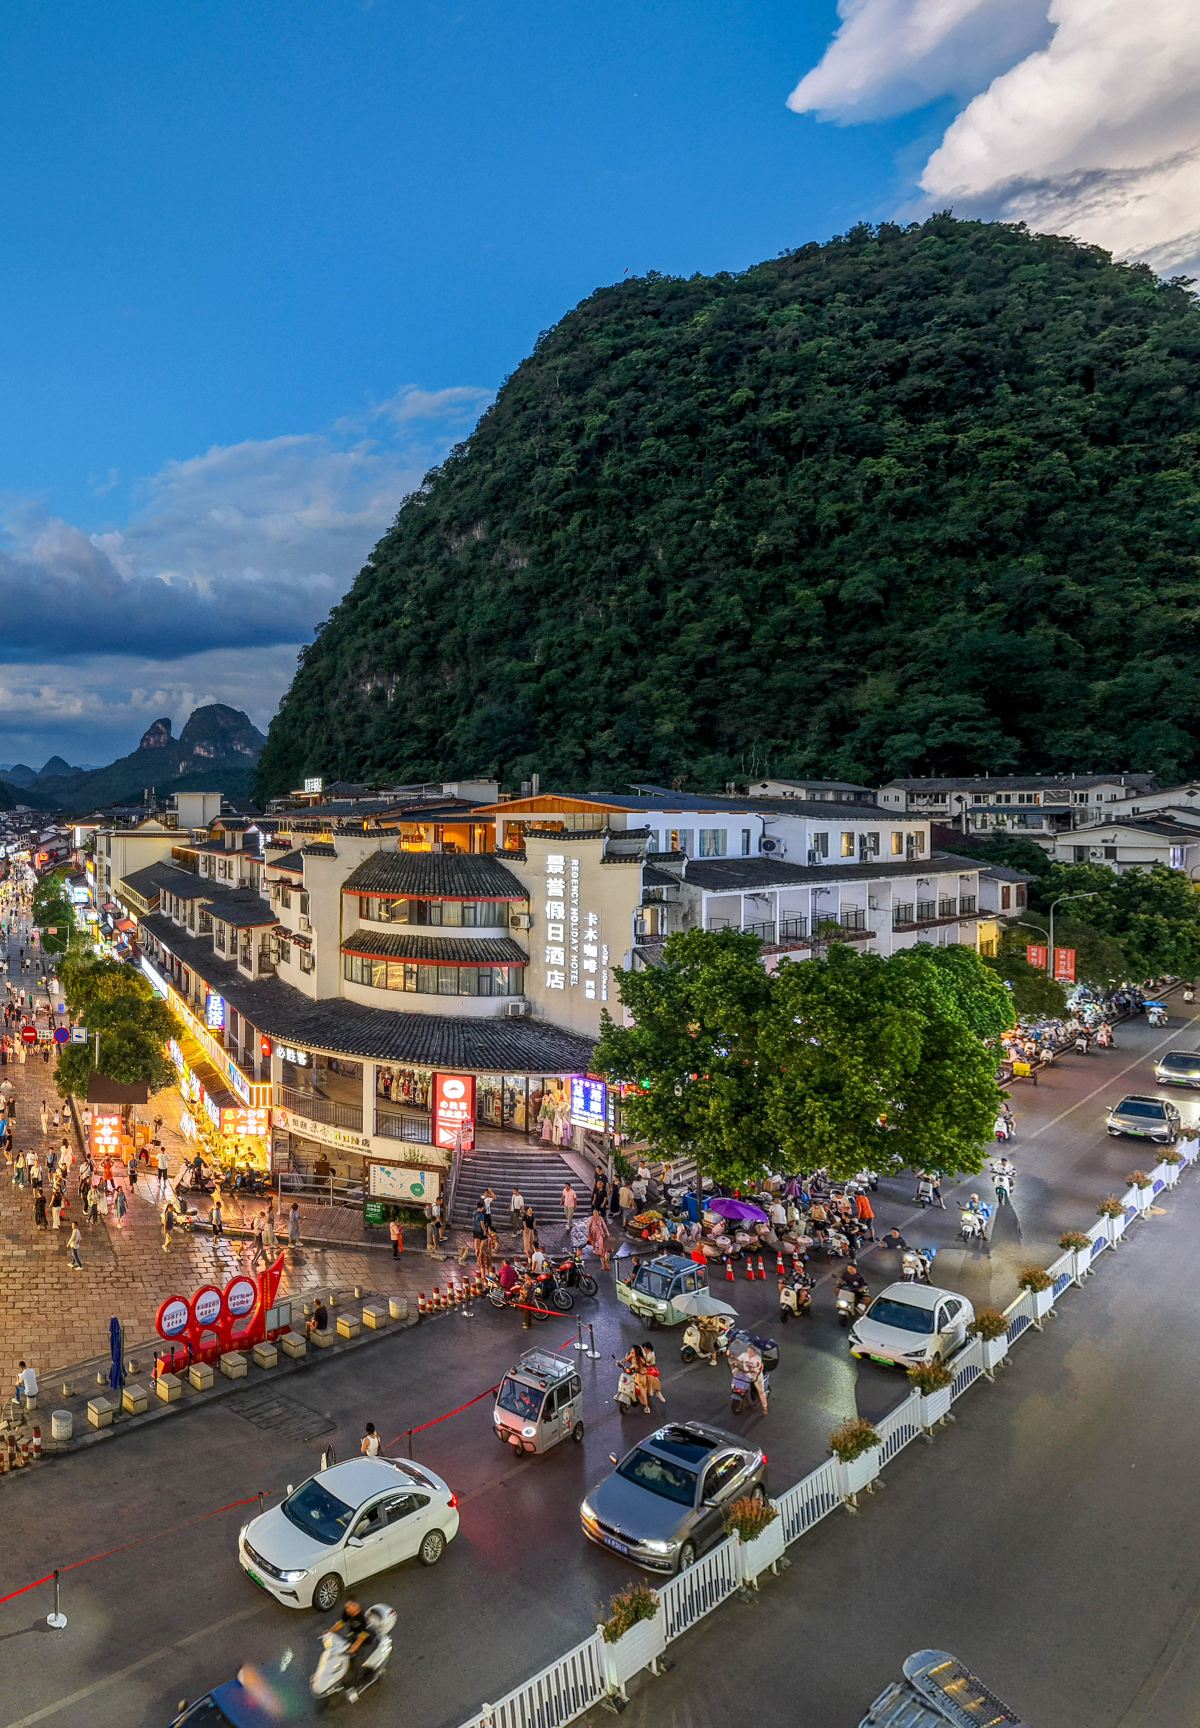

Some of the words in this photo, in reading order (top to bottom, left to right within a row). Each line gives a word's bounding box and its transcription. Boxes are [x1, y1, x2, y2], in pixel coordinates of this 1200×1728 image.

[571, 859, 579, 905] REGENCY
[546, 855, 565, 990] 景誉假日酒店
[571, 908, 579, 952] HOLIDAY
[571, 955, 579, 987] HOTEL
[208, 995, 224, 1026] 足浴
[276, 1046, 307, 1066] 必胜客
